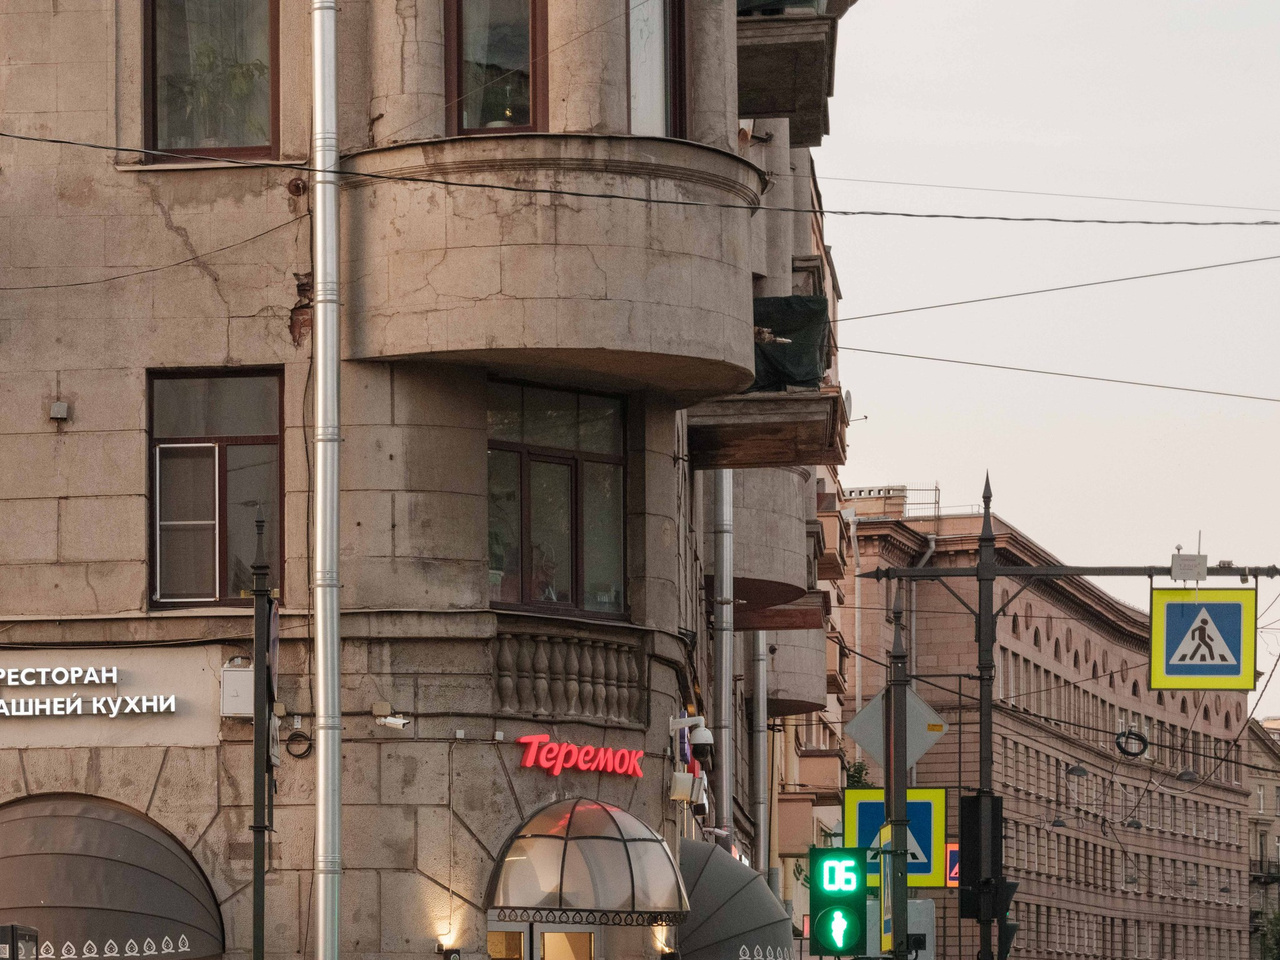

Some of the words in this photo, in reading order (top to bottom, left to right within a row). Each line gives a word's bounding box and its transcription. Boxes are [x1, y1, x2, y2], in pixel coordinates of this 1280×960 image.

[92, 694, 176, 718] КУХНИ
[516, 734, 644, 778] Теремок
[823, 860, 857, 891] 06
